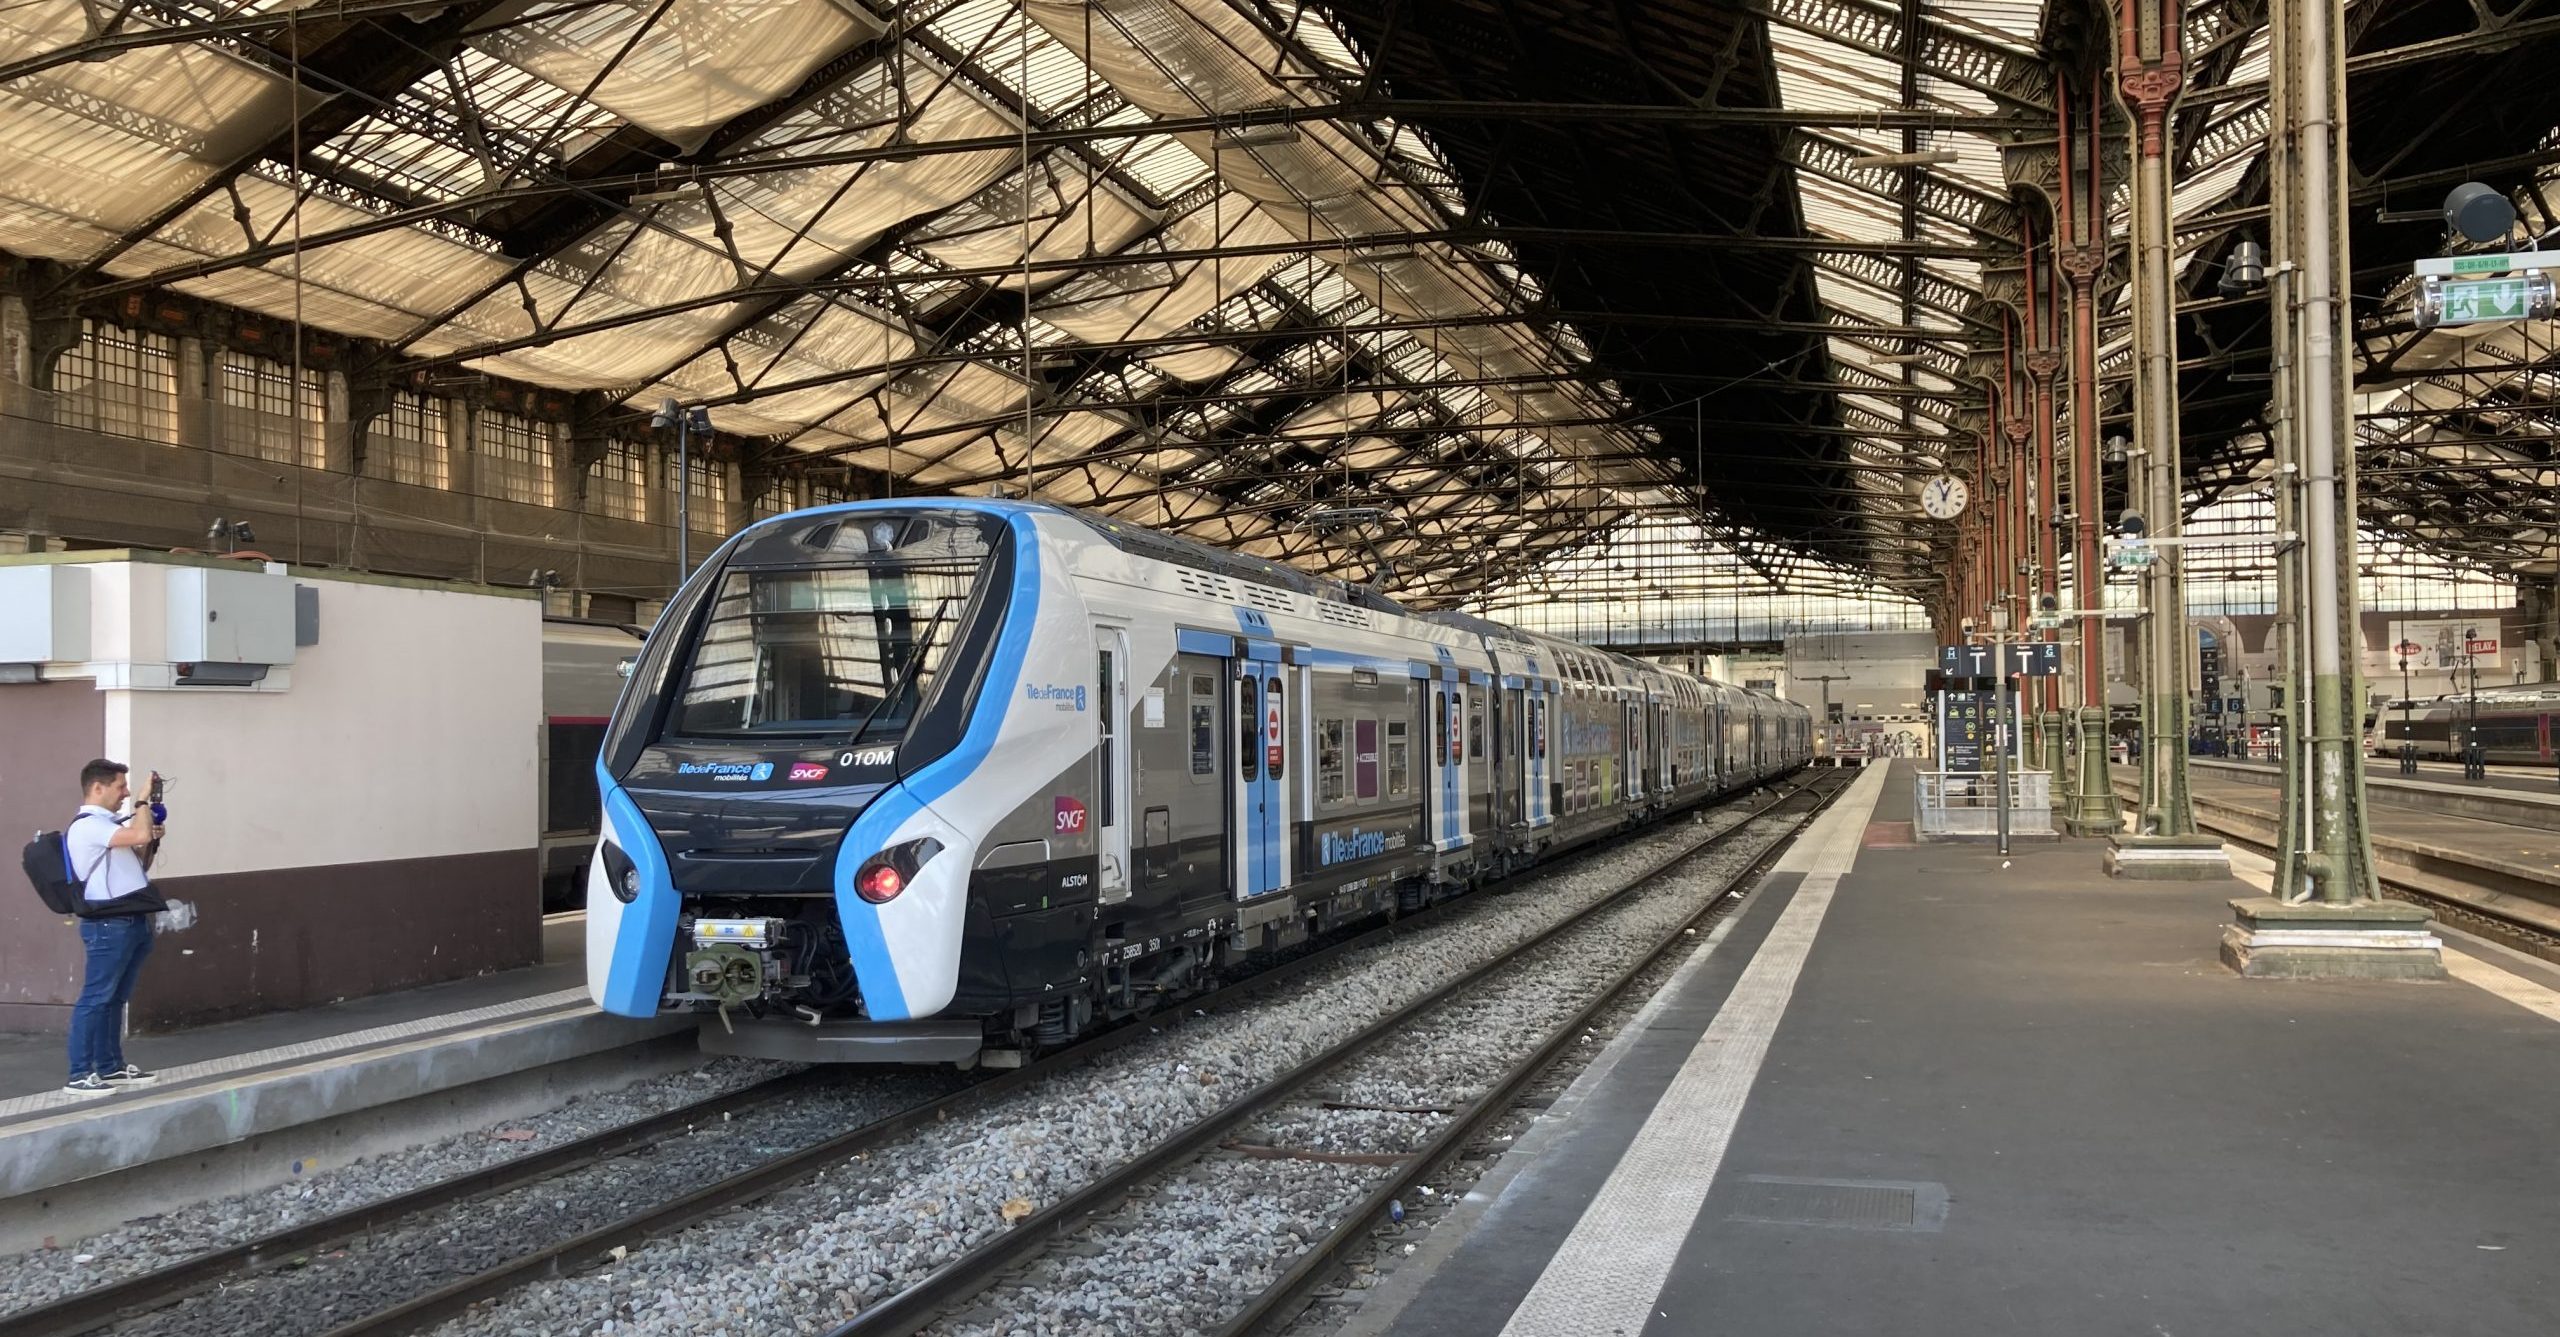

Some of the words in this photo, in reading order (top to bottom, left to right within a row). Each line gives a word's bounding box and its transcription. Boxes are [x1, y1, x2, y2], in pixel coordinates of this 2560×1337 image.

[1947, 650, 1956, 658] H
[2045, 648, 2054, 656] G
[1969, 652, 1986, 675] T
[2016, 651, 2034, 674] T
[840, 750, 895, 767] 010M
[714, 774, 748, 782] mobilités
[789, 769, 826, 780] SNCF
[1056, 809, 1085, 830] SNCF
[1062, 873, 1088, 888] ALSTOM
[1093, 906, 1099, 919] 2
